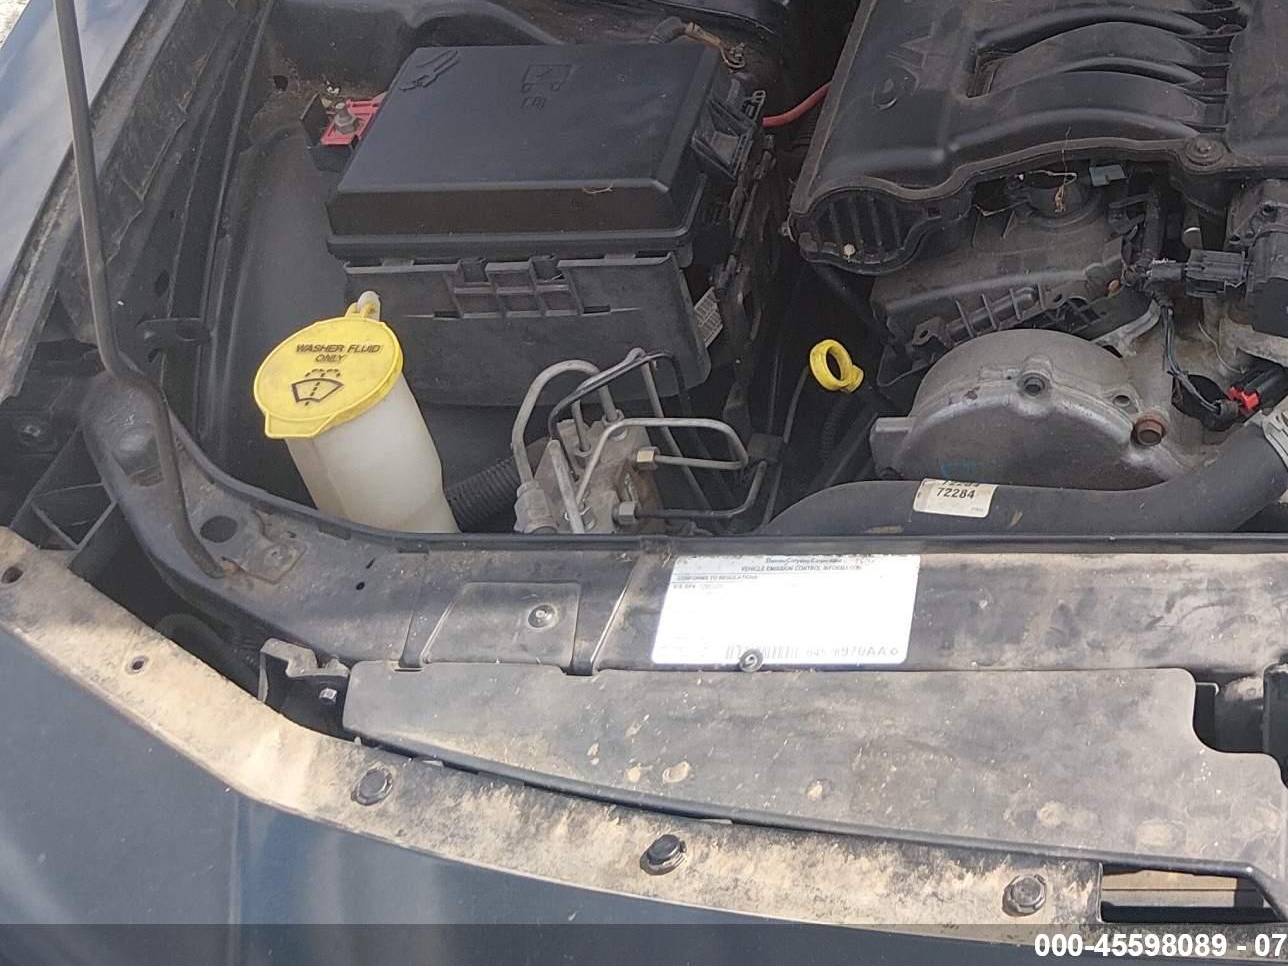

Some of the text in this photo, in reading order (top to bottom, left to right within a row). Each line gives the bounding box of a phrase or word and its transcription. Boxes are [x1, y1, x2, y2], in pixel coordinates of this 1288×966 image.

[295, 344, 382, 353] WASHER FLUID
[315, 354, 346, 363] ONLY
[936, 487, 976, 500] 72284
